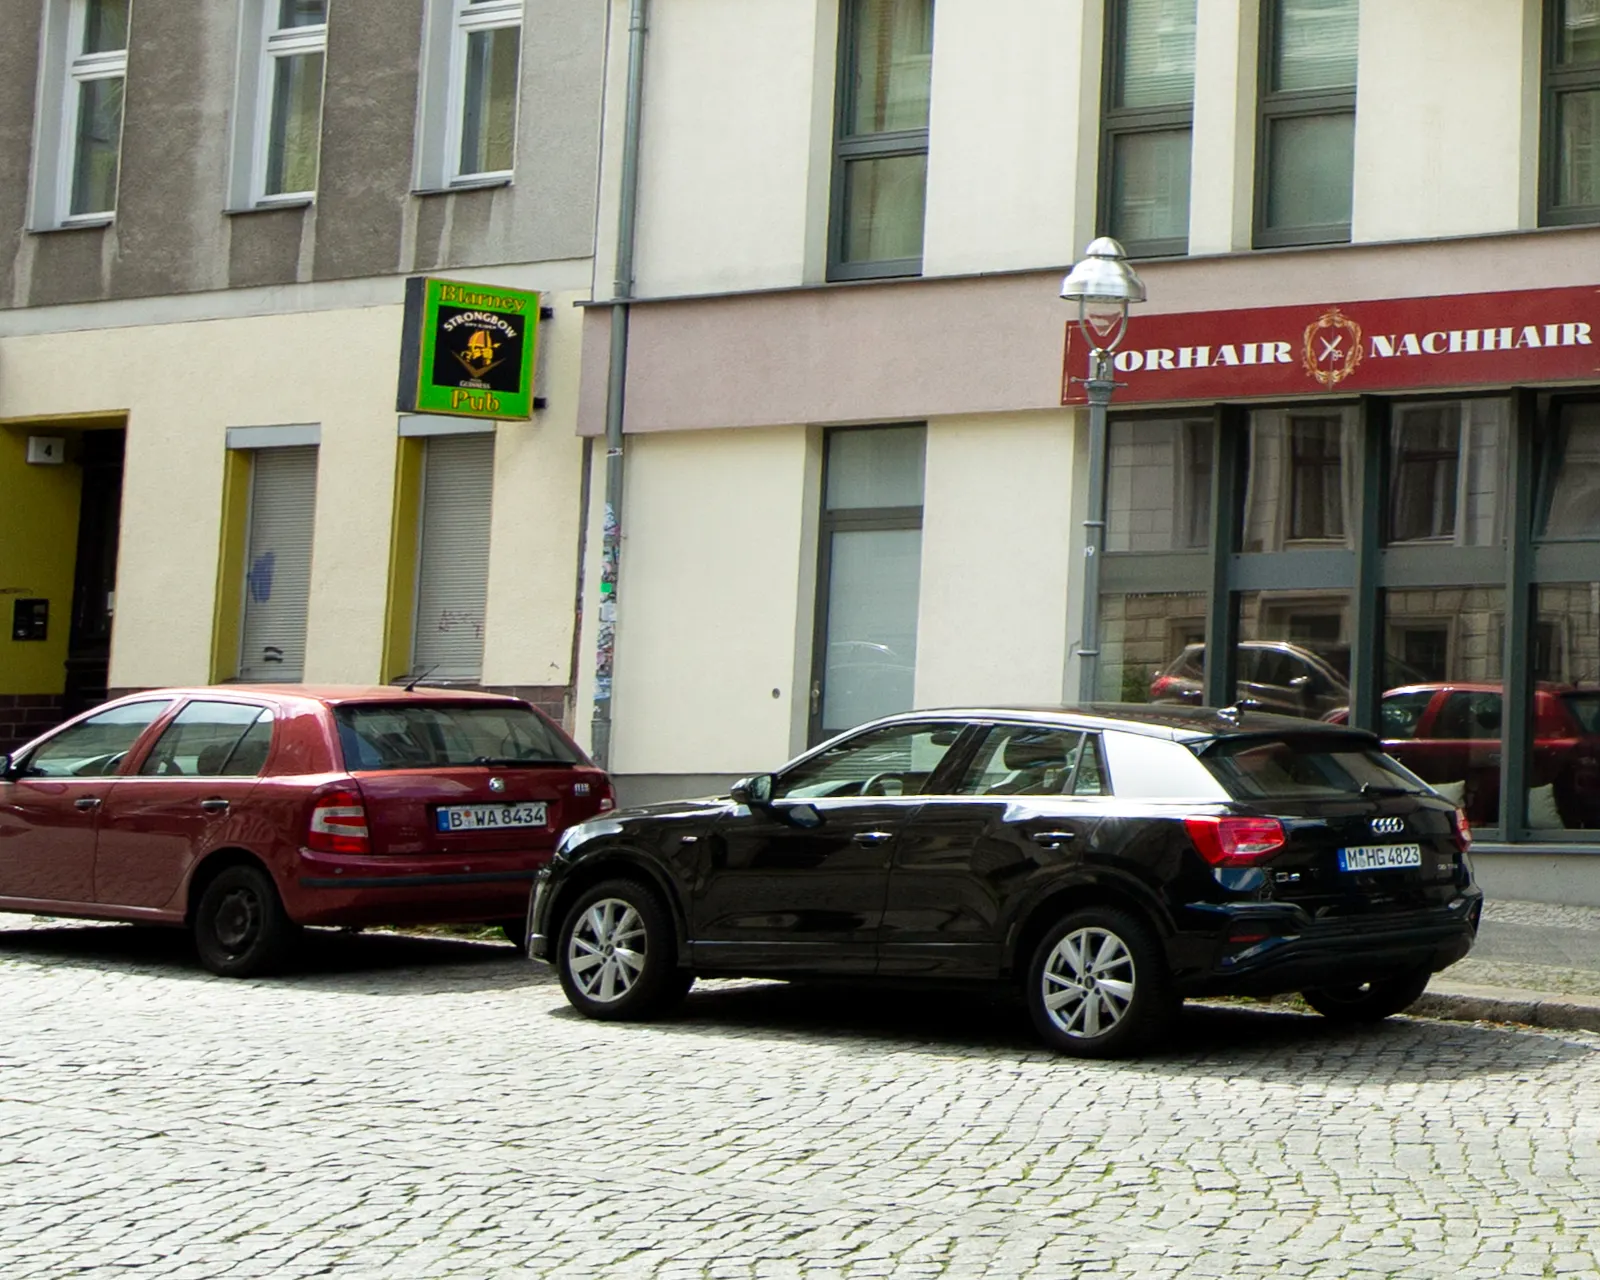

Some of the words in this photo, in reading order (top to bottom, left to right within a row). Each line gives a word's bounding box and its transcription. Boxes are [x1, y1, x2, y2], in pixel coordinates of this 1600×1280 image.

[439, 283, 526, 313] Blarney
[443, 311, 518, 339] STRONGBOW
[1103, 340, 1293, 373] ORHAIR
[1369, 321, 1593, 358] NACHHAIR
[451, 389, 500, 412] Pub
[44, 443, 53, 457] 4
[451, 811, 463, 828] B
[474, 810, 498, 826] WA
[501, 808, 544, 825] 8434
[1348, 852, 1358, 868] M
[1366, 850, 1385, 866] HG
[1388, 846, 1420, 865] 4823
